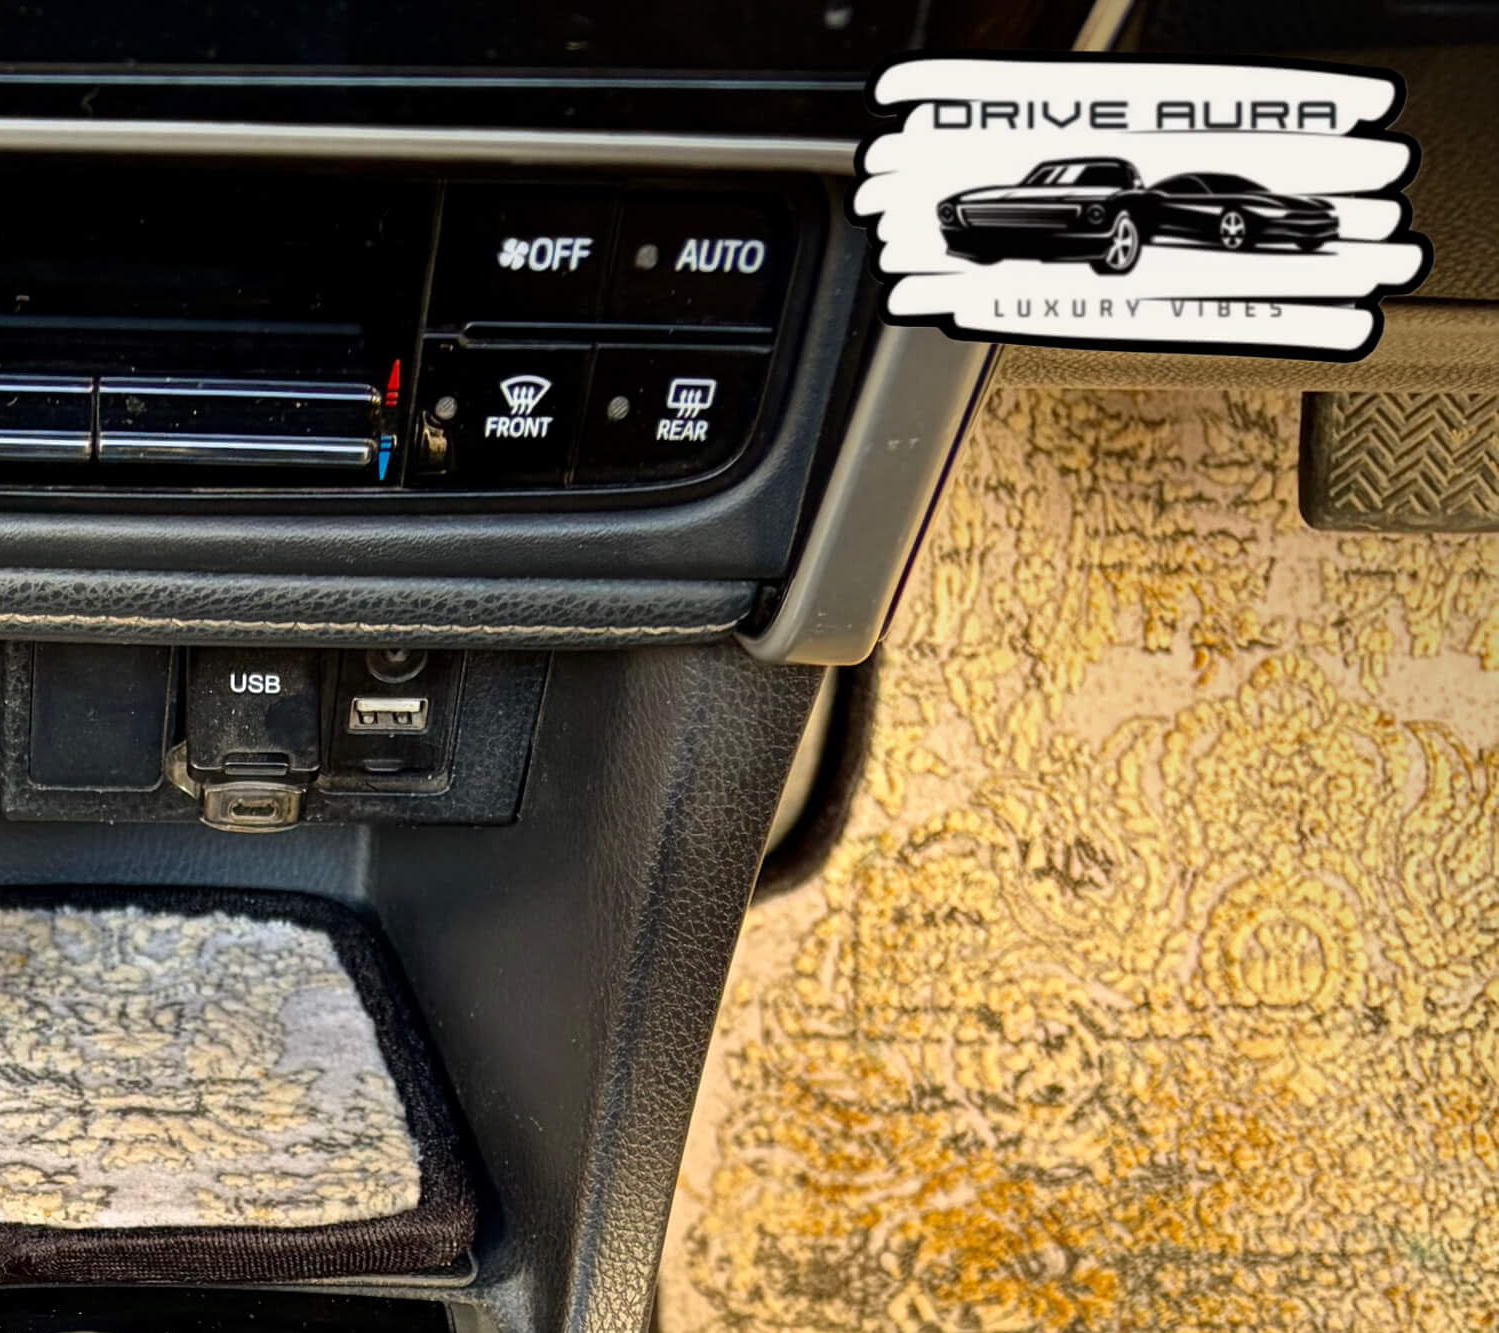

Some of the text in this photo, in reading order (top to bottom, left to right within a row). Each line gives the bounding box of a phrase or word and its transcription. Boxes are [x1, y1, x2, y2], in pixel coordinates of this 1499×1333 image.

[528, 237, 593, 271] OFF
[675, 239, 765, 274] AUTO
[484, 416, 554, 439] FRONT
[656, 418, 709, 442] REAR
[229, 673, 282, 695] USB
